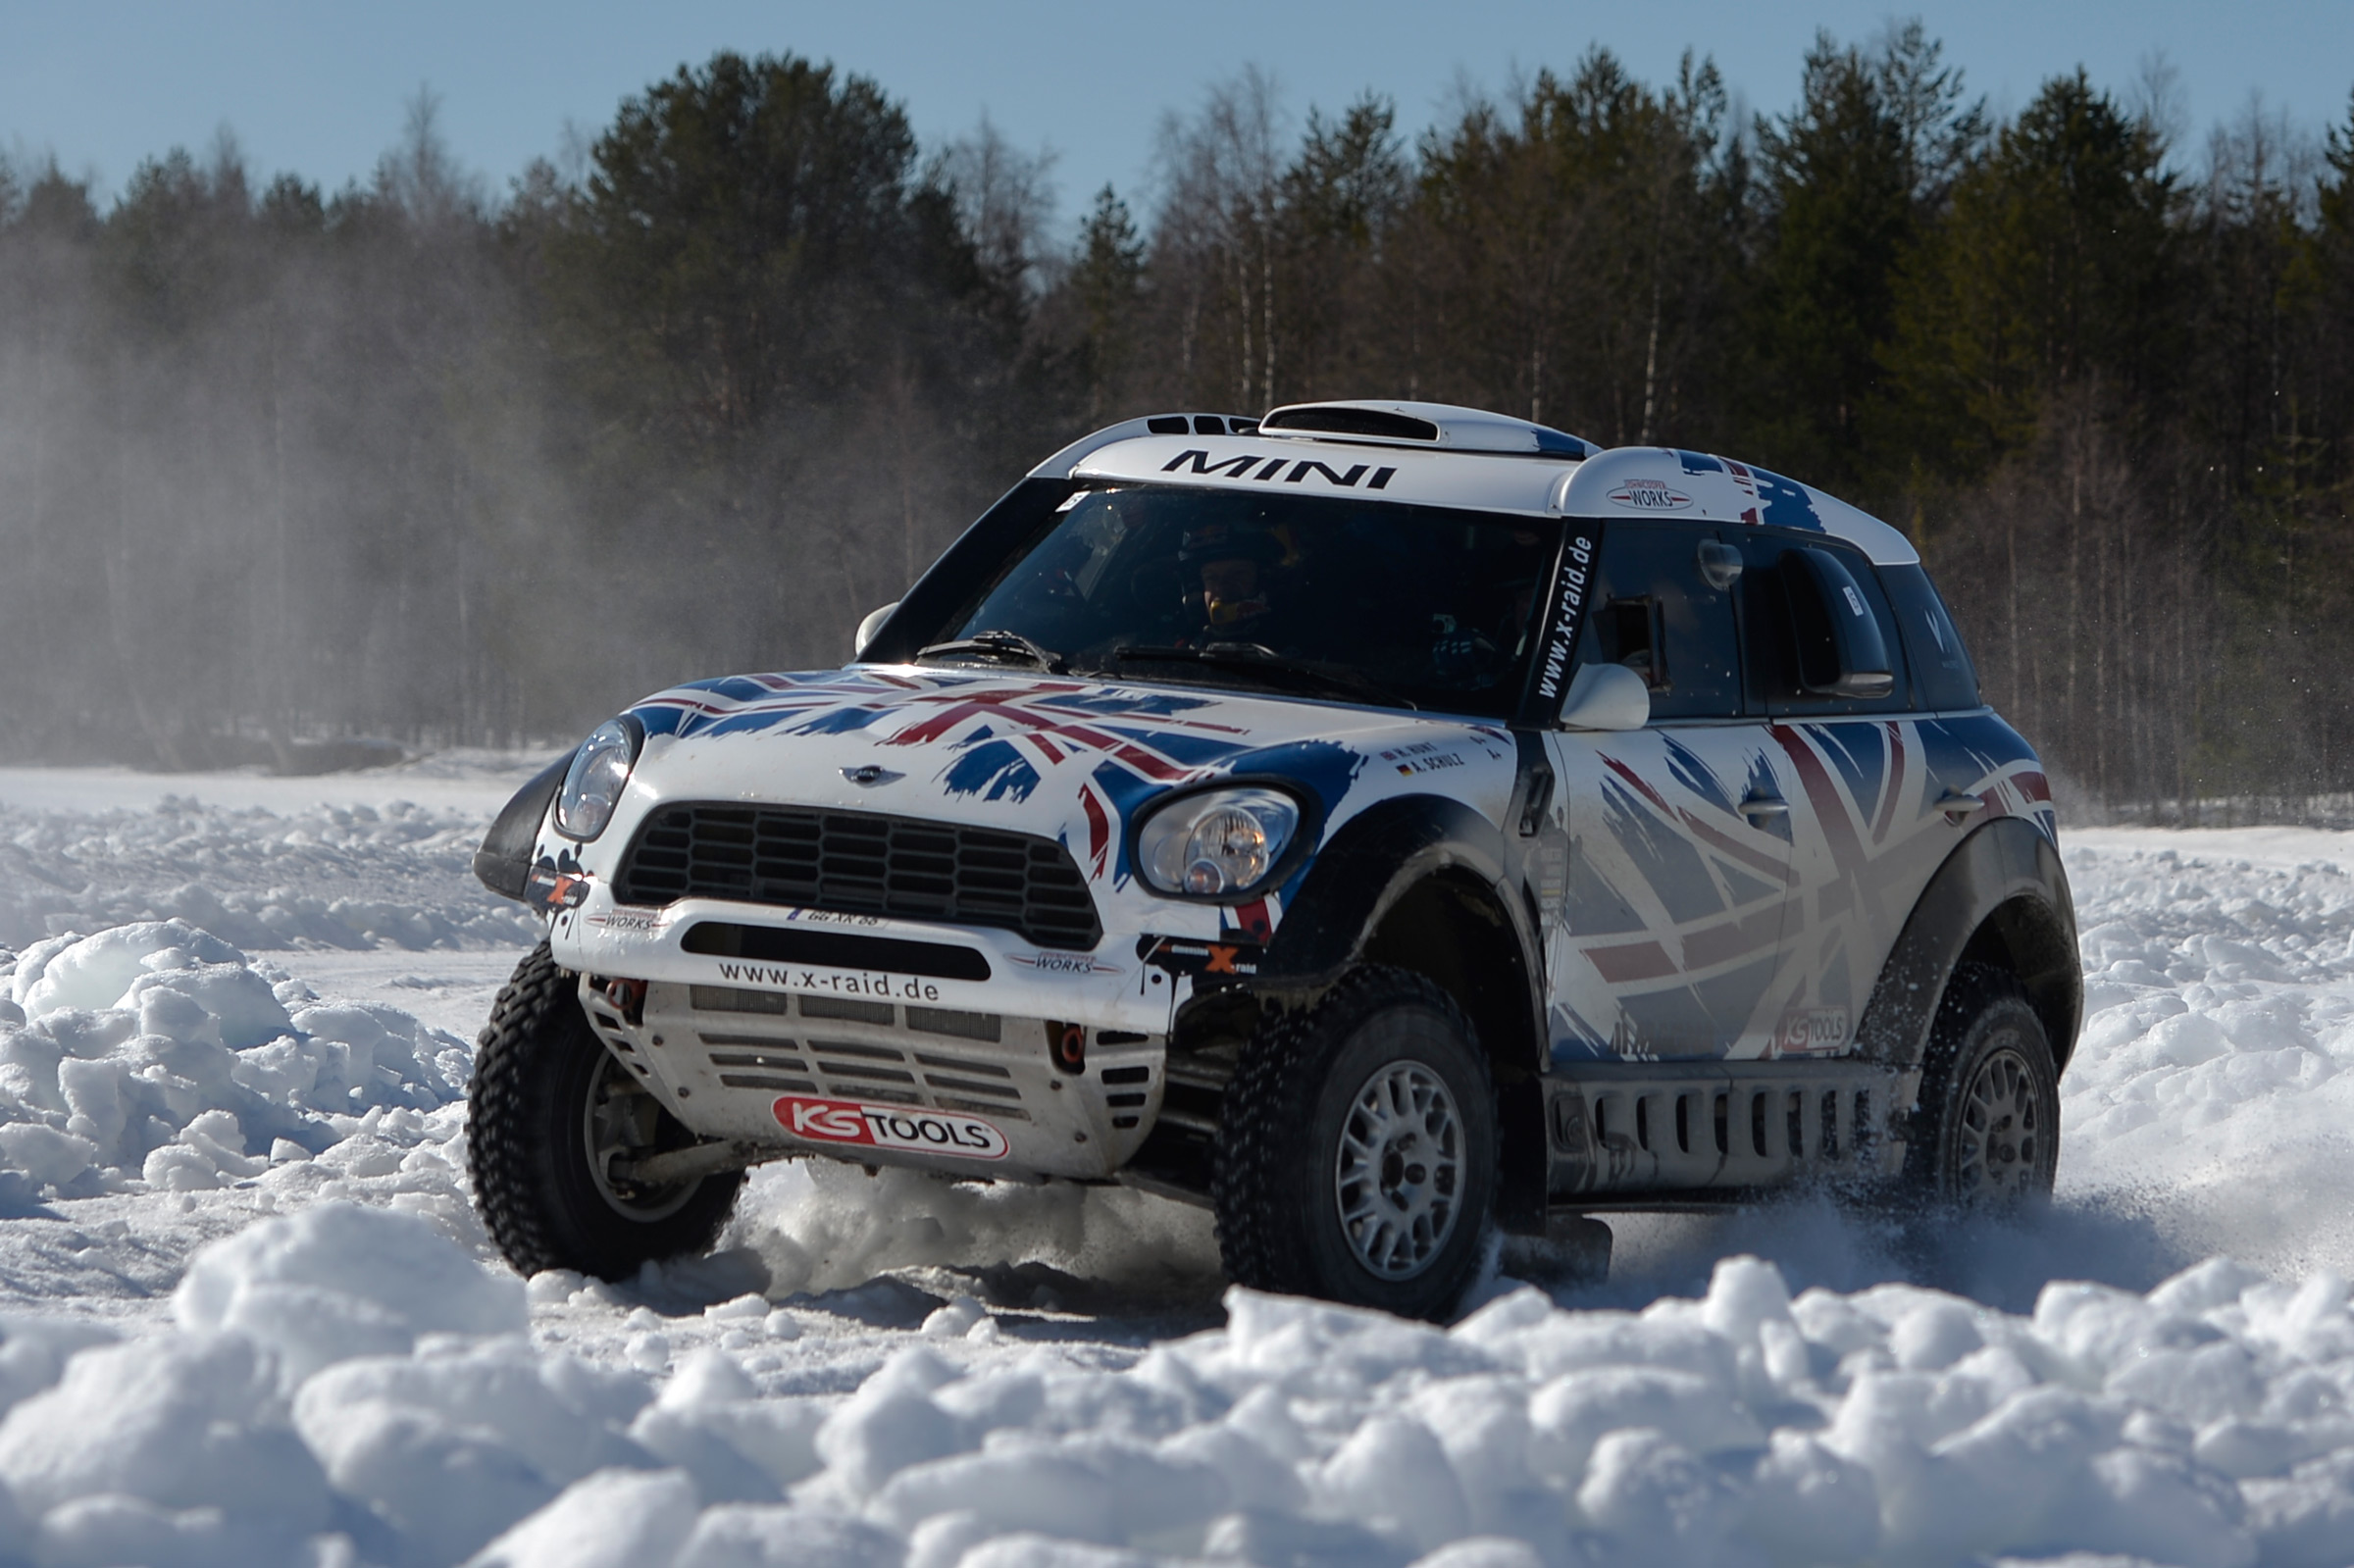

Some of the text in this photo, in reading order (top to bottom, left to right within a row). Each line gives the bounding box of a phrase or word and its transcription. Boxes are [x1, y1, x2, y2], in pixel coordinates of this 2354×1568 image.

[1160, 449, 1399, 490] MINI
[1628, 490, 1673, 507] WORKS
[1538, 536, 1592, 699] www.x-raid.de
[1422, 752, 1465, 771] SCHULZ
[605, 914, 653, 931] WORKS
[1036, 955, 1092, 974] WORKS
[719, 963, 940, 1001] www.x-raid.de
[1808, 1016, 1843, 1041] TOOLS
[793, 1101, 992, 1149] KS TOOLS
